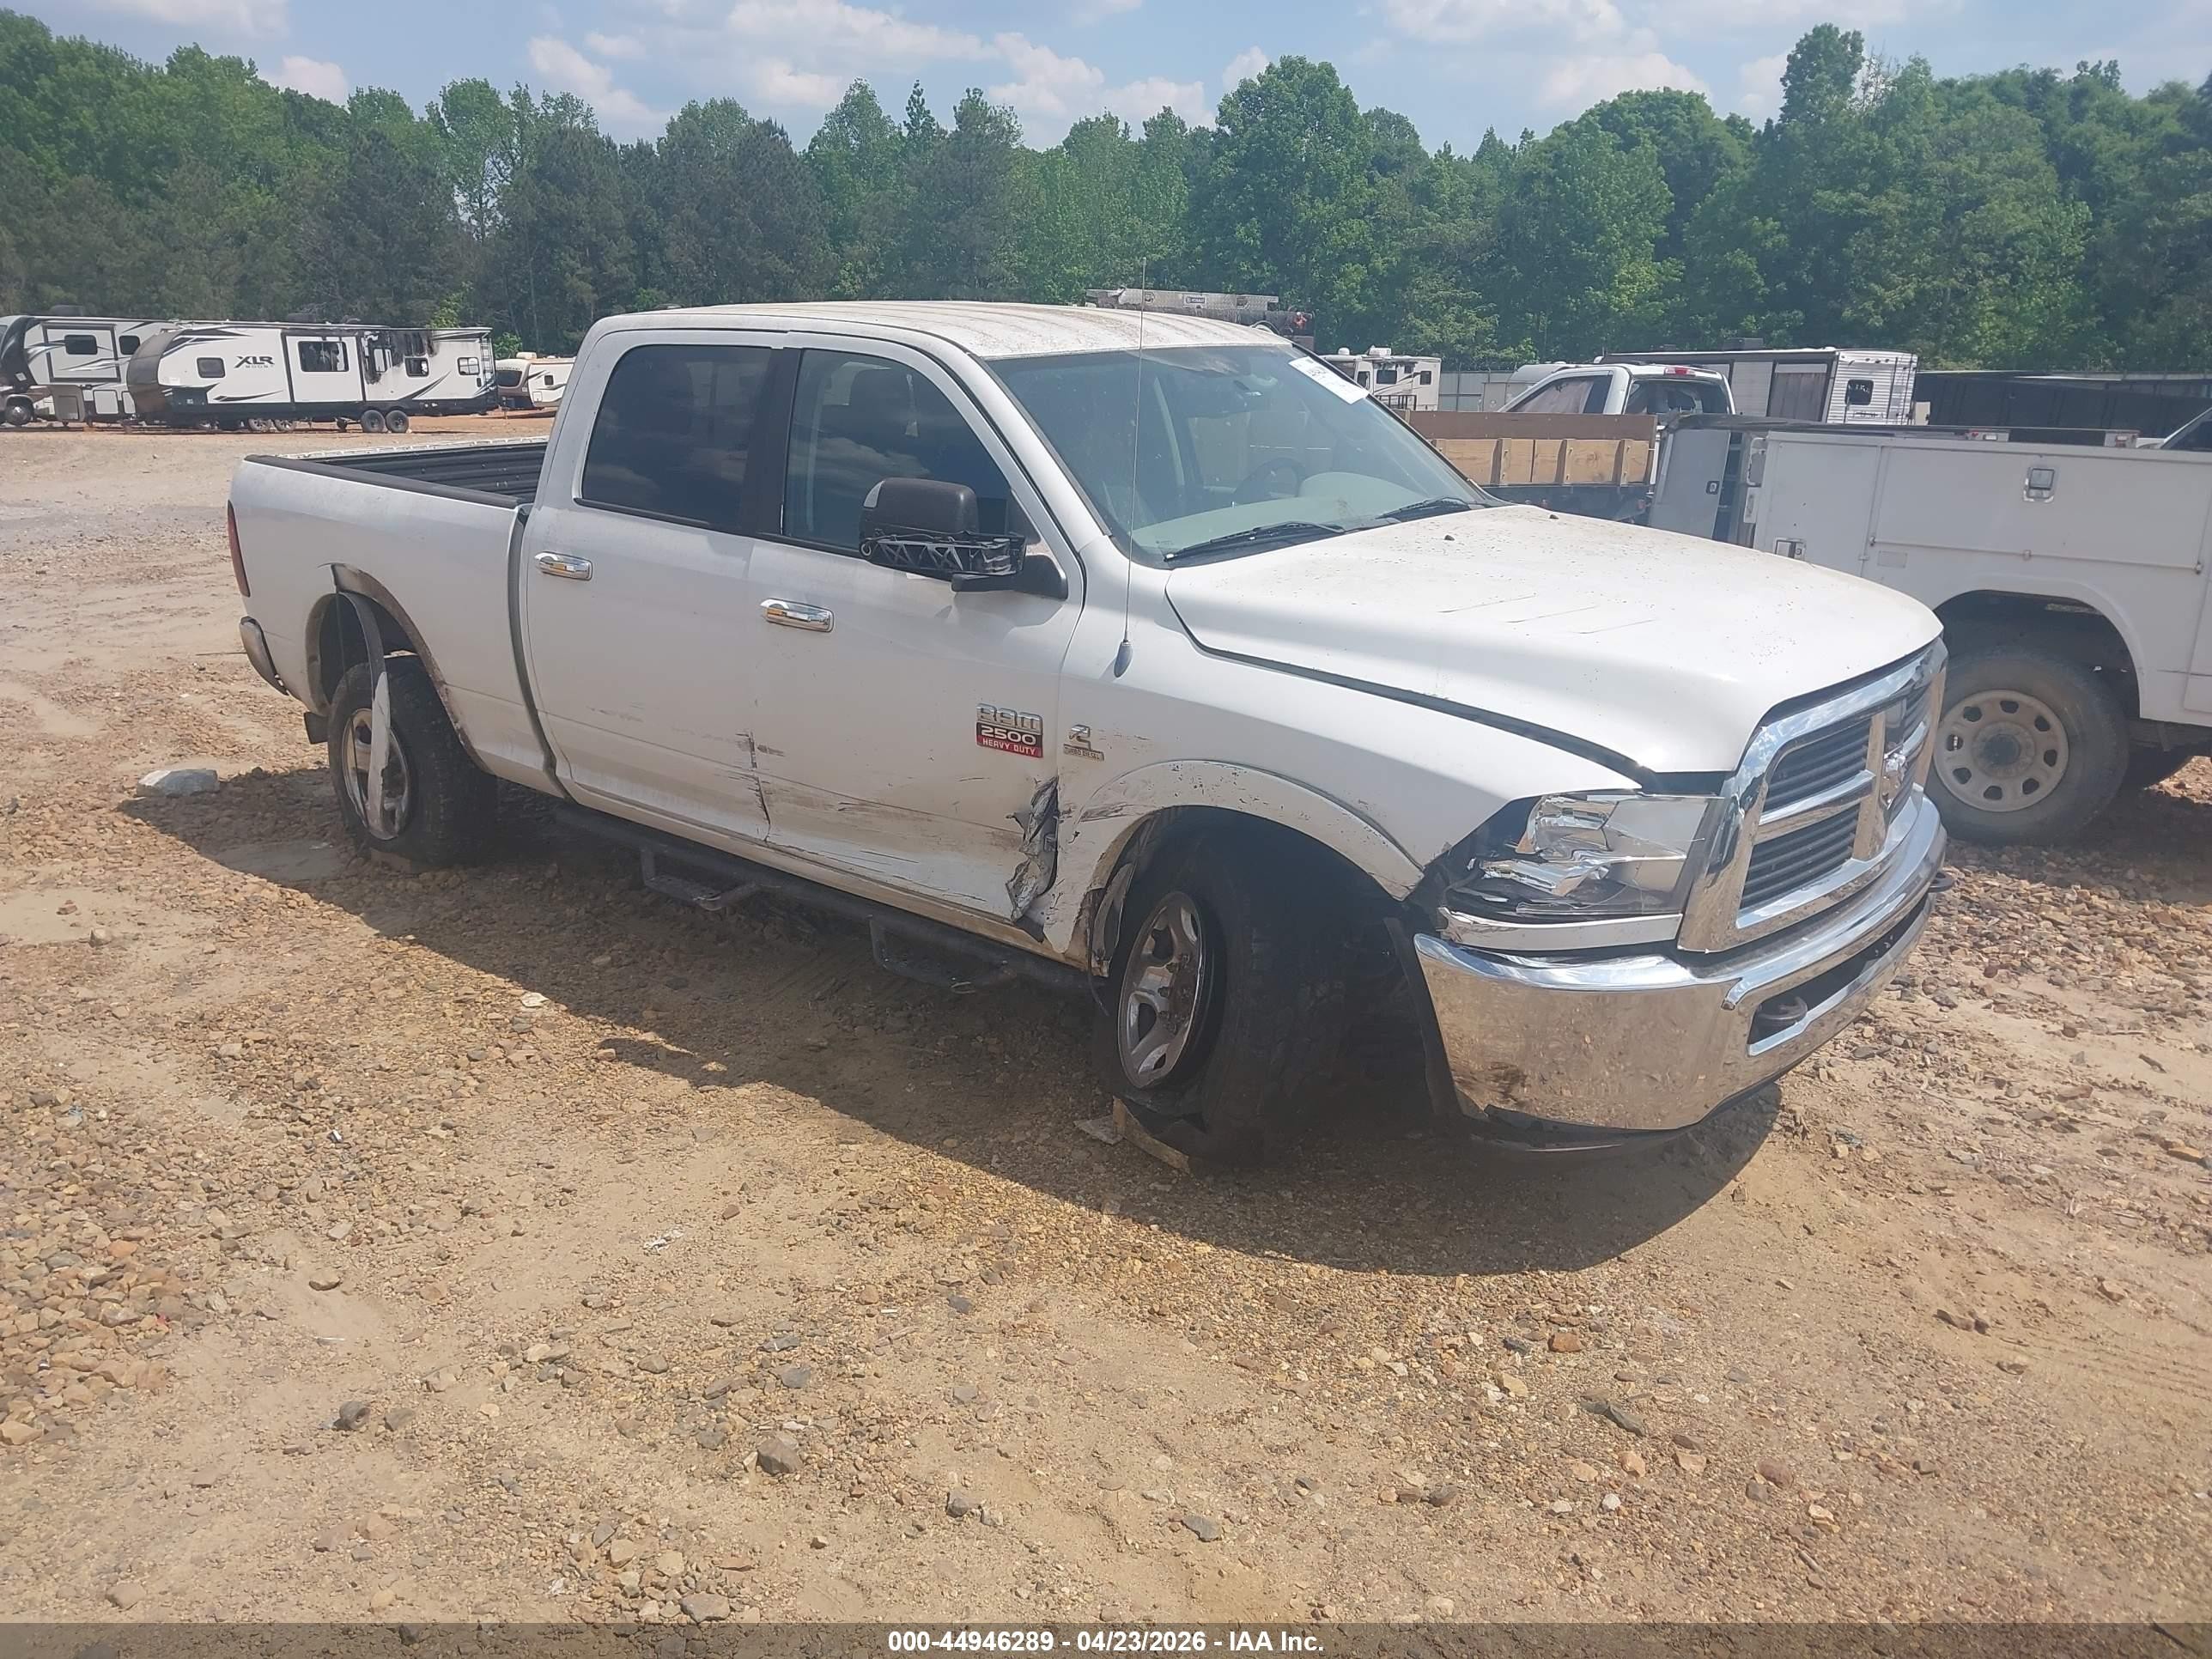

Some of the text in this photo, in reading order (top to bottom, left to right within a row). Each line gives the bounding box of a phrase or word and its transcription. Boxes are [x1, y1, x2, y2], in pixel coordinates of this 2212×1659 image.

[234, 356, 275, 368] XLR
[981, 725, 1036, 745] 2500
[982, 738, 1036, 757] HEAVY DUTY
